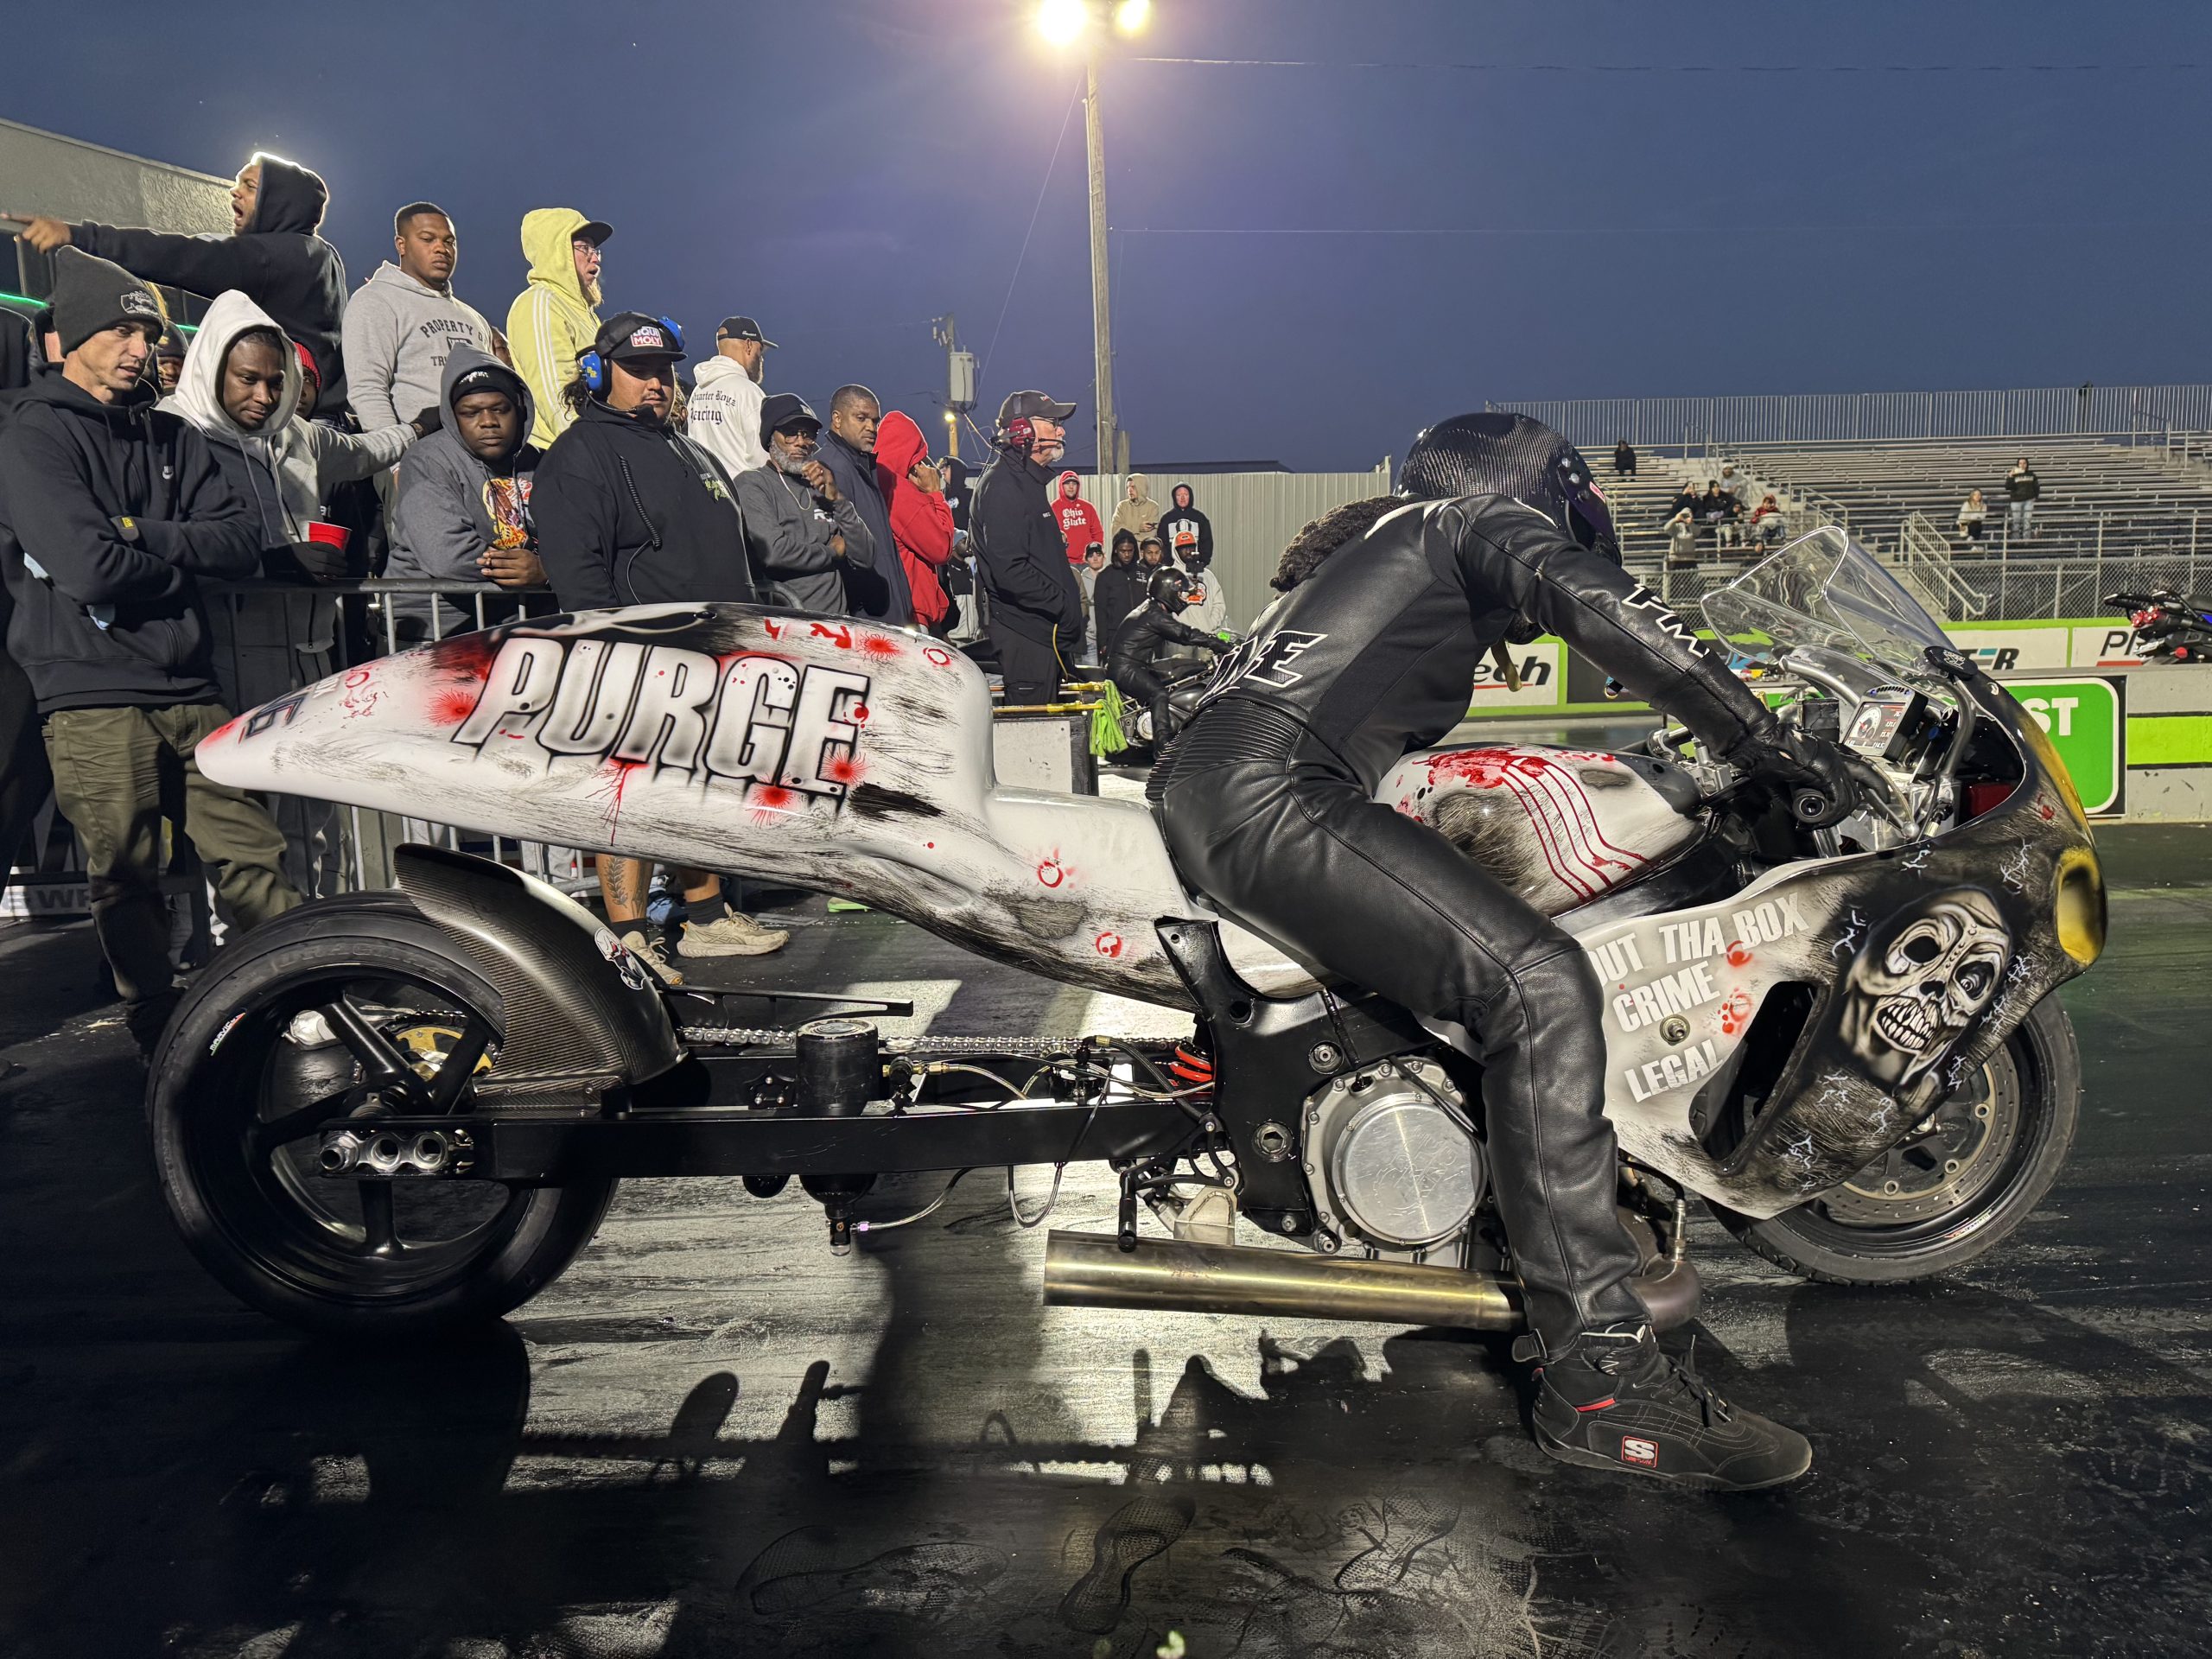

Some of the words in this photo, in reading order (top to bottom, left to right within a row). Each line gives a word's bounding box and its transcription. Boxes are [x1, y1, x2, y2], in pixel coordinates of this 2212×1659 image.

[419, 319, 474, 339] PROPERTY
[633, 335, 660, 344] MOLY
[430, 355, 448, 366] TR
[1062, 507, 1084, 518] Ohio
[1063, 517, 1087, 531] State
[451, 637, 870, 794] PURGE
[1658, 916, 1729, 964] THA
[1732, 892, 1810, 950] BOX
[1612, 960, 1721, 1033] CRIME
[1624, 1039, 1724, 1103] LEGAL
